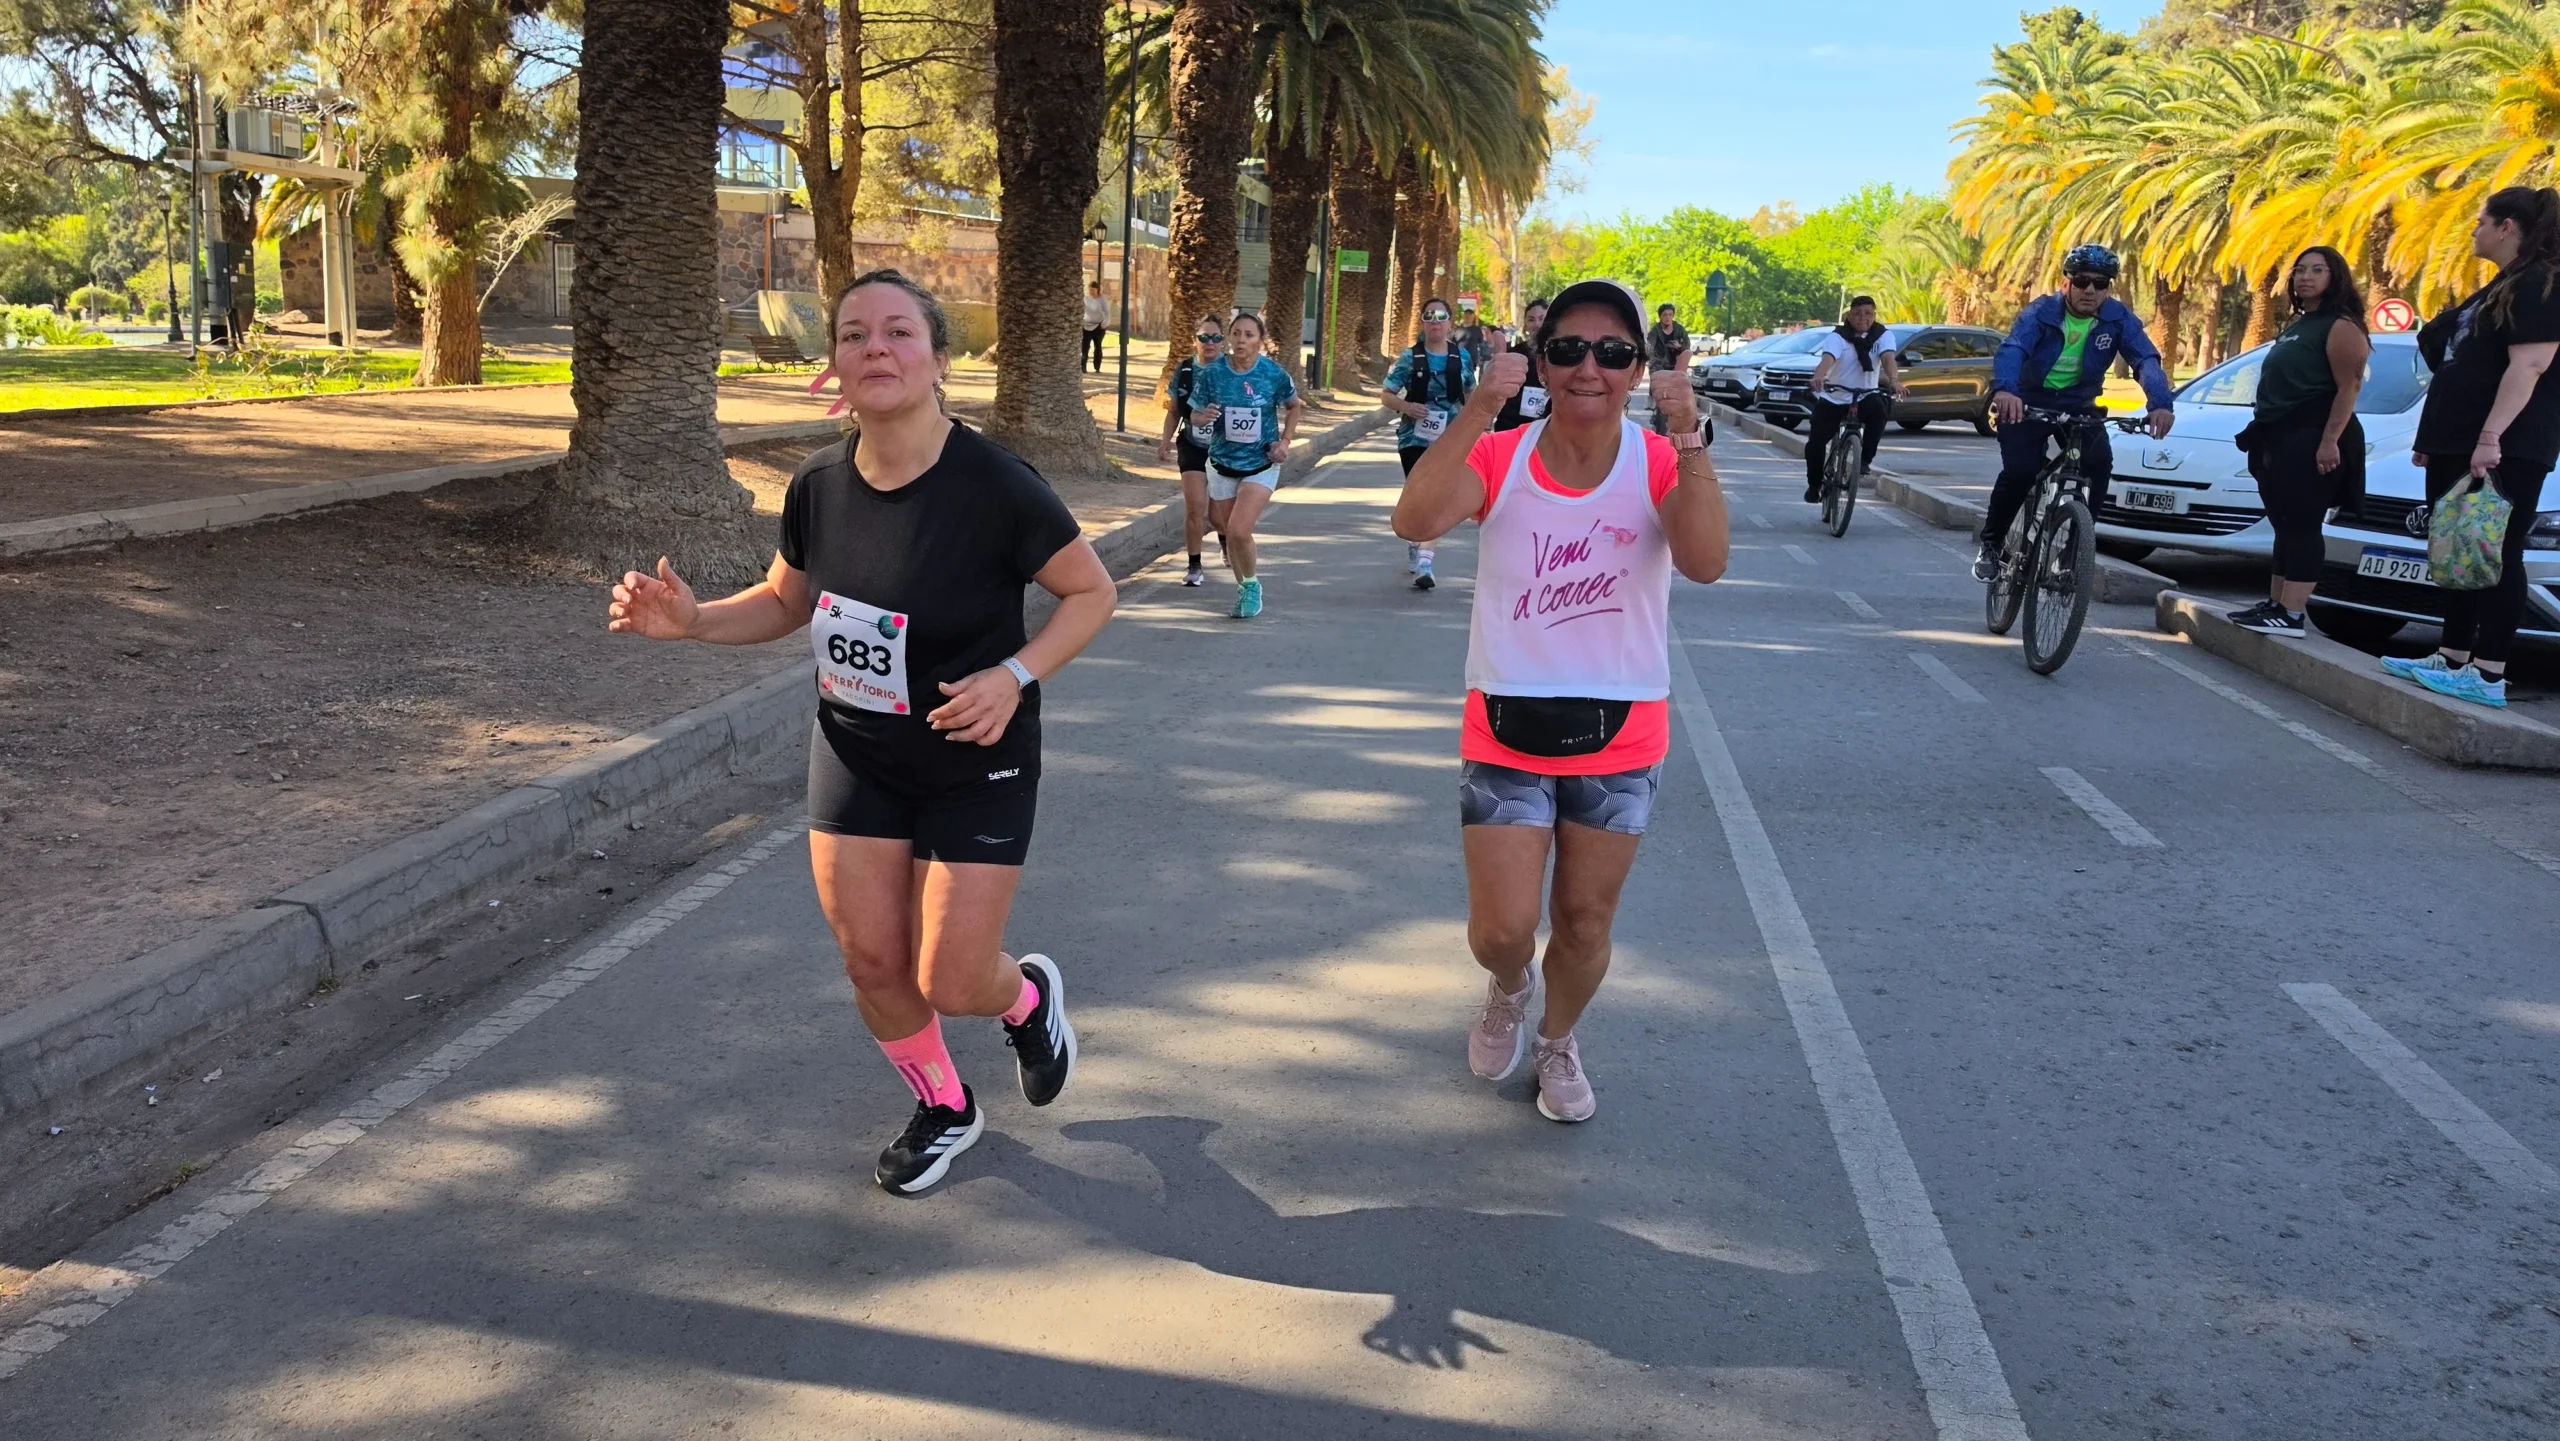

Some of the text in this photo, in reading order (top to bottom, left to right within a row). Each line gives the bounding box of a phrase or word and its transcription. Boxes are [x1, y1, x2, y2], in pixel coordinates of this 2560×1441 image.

[1198, 424, 1213, 435] 56
[1231, 419, 1257, 431] 507
[1421, 419, 1440, 431] 516
[2126, 491, 2174, 510] LDM 698
[1532, 519, 1600, 578] Vení
[2362, 557, 2385, 574] AD
[2389, 561, 2421, 580] 920
[829, 605, 843, 620] 5k
[1513, 588, 1532, 621] a
[828, 634, 892, 676] 683
[828, 672, 897, 700] TERRITORIO
